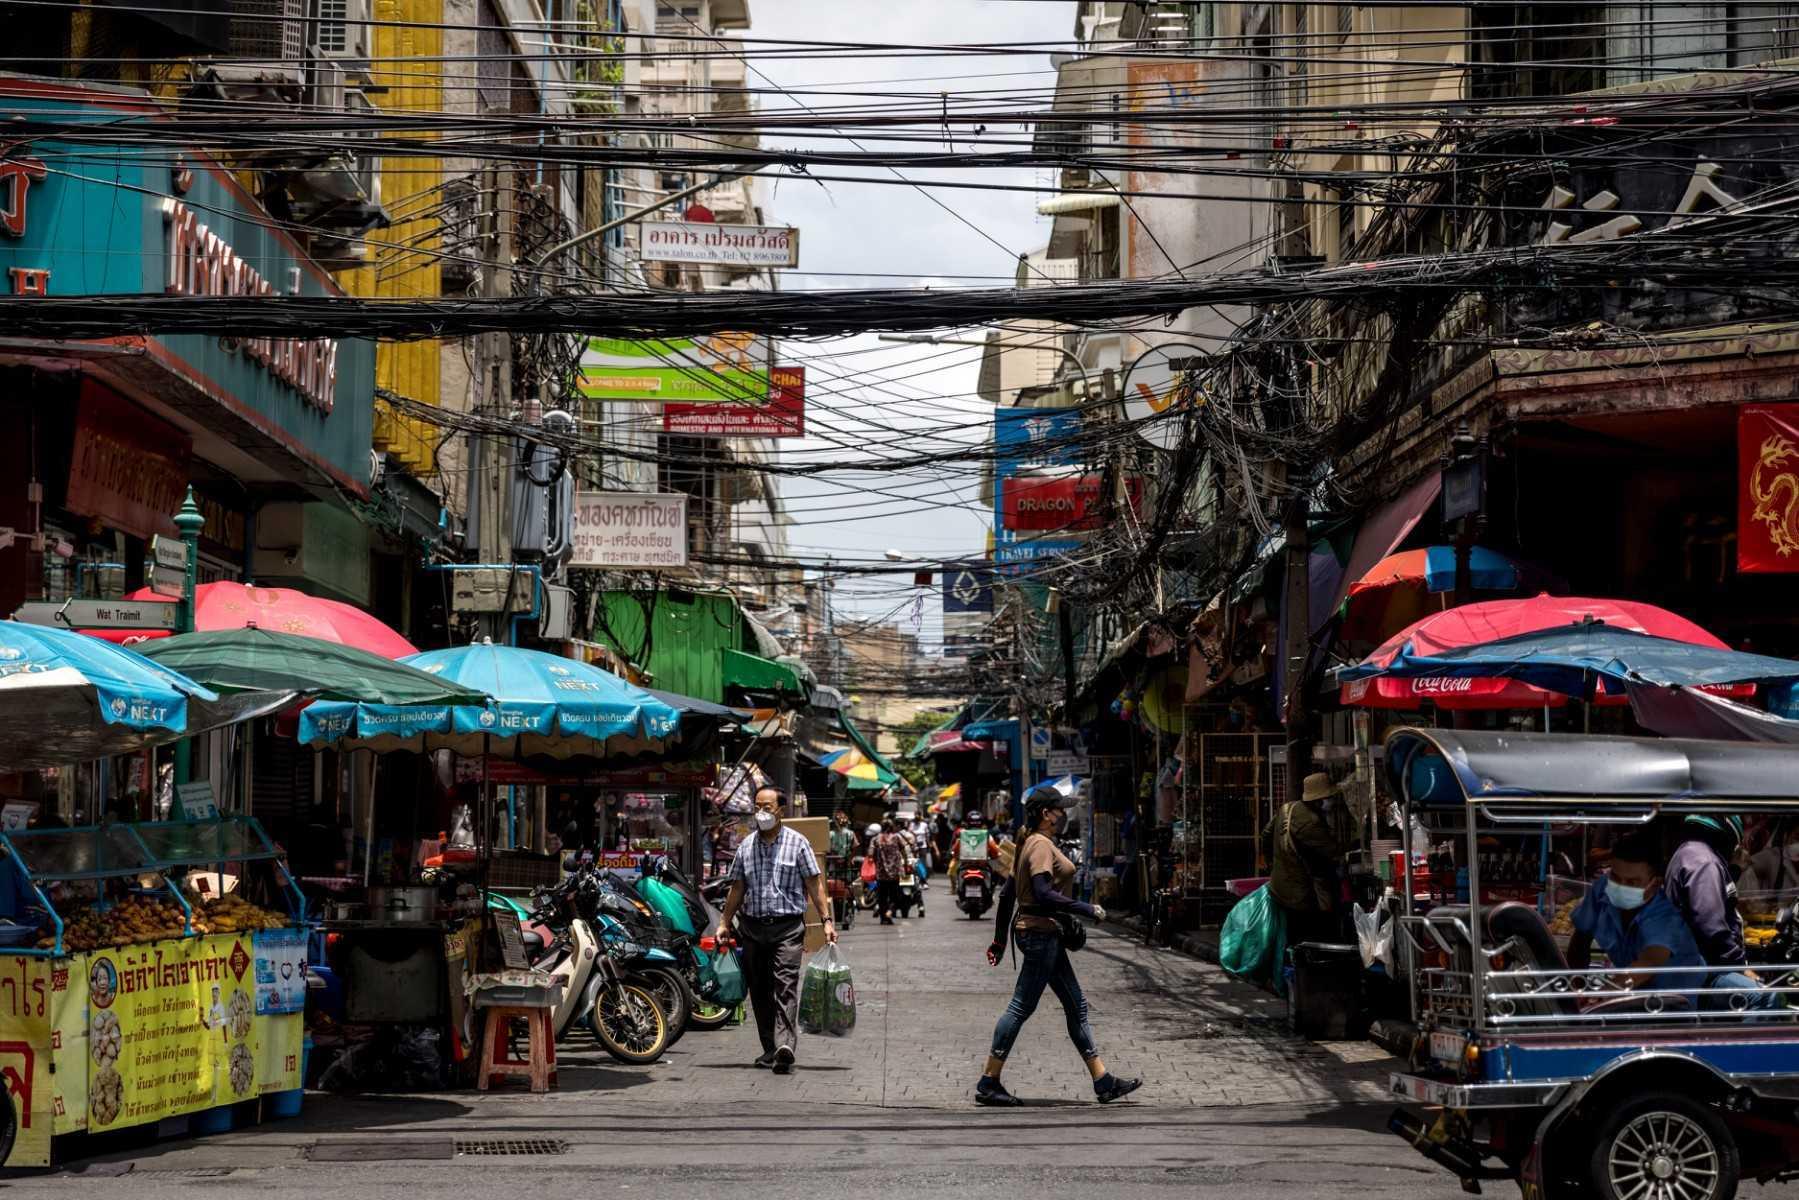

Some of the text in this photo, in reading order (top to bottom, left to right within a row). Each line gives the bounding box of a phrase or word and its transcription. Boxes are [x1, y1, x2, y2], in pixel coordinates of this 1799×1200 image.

[649, 229, 697, 246] อาคาร
[1017, 498, 1075, 512] DRAGON
[96, 608, 140, 621] Wat Traimit
[130, 706, 167, 721] NEXT
[501, 716, 540, 728] NEXT
